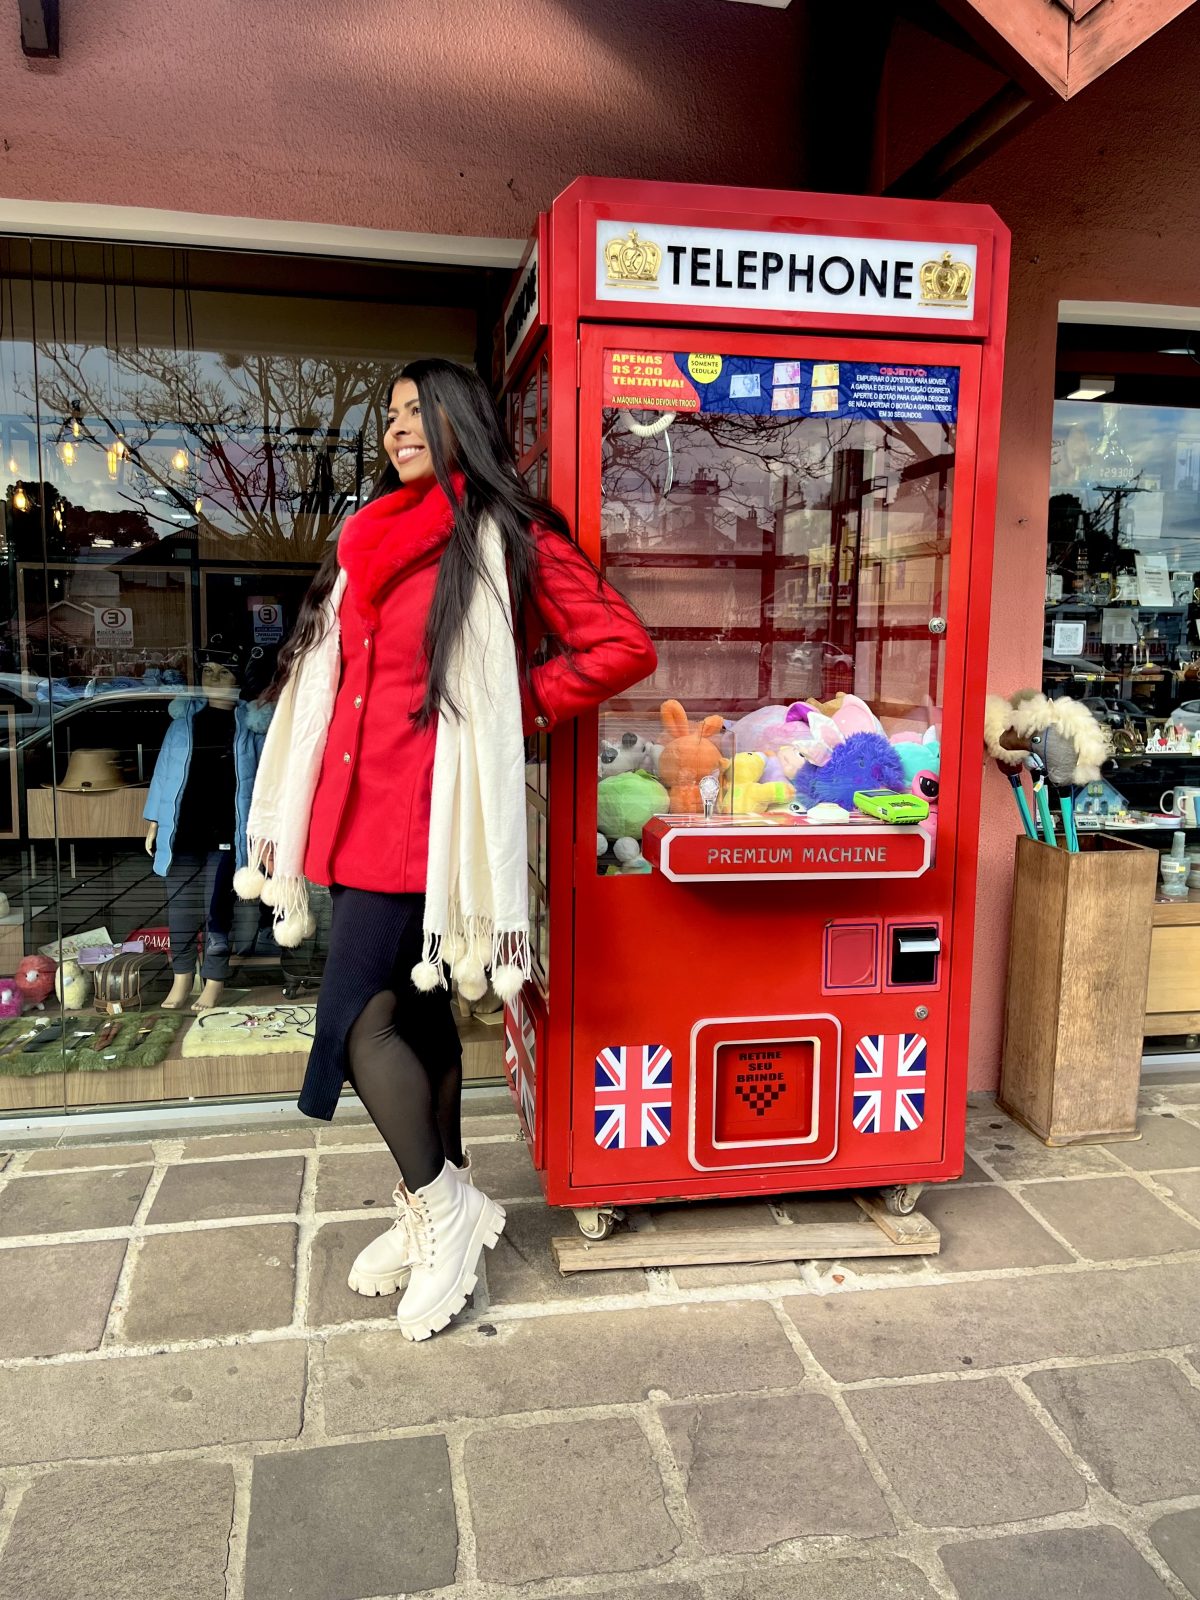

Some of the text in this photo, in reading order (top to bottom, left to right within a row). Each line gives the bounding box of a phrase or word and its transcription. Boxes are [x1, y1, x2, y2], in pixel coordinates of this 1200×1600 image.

[667, 245, 914, 300] TELEPHONE
[612, 353, 662, 365] APENAS
[612, 365, 630, 374] R$
[880, 367, 927, 376] OBJETIVO:
[612, 376, 684, 388] TENTATIVA!
[889, 376, 914, 384] JOYSTICK
[904, 385, 926, 394] POSIÇÃO
[878, 392, 896, 400] BOTÃO
[928, 395, 949, 403] DESCER
[655, 398, 678, 407] DEVOLVE
[679, 399, 696, 408] TROCO
[855, 400, 867, 408] NÃO
[867, 401, 890, 409] APERTAR
[895, 402, 912, 410] BOTÃO
[935, 404, 952, 412] DESCE
[707, 846, 888, 864] PREMIUM MACHINE
[739, 1050, 783, 1061] RETIRE
[748, 1062, 772, 1071] SEU
[737, 1072, 784, 1082] BRINDE
